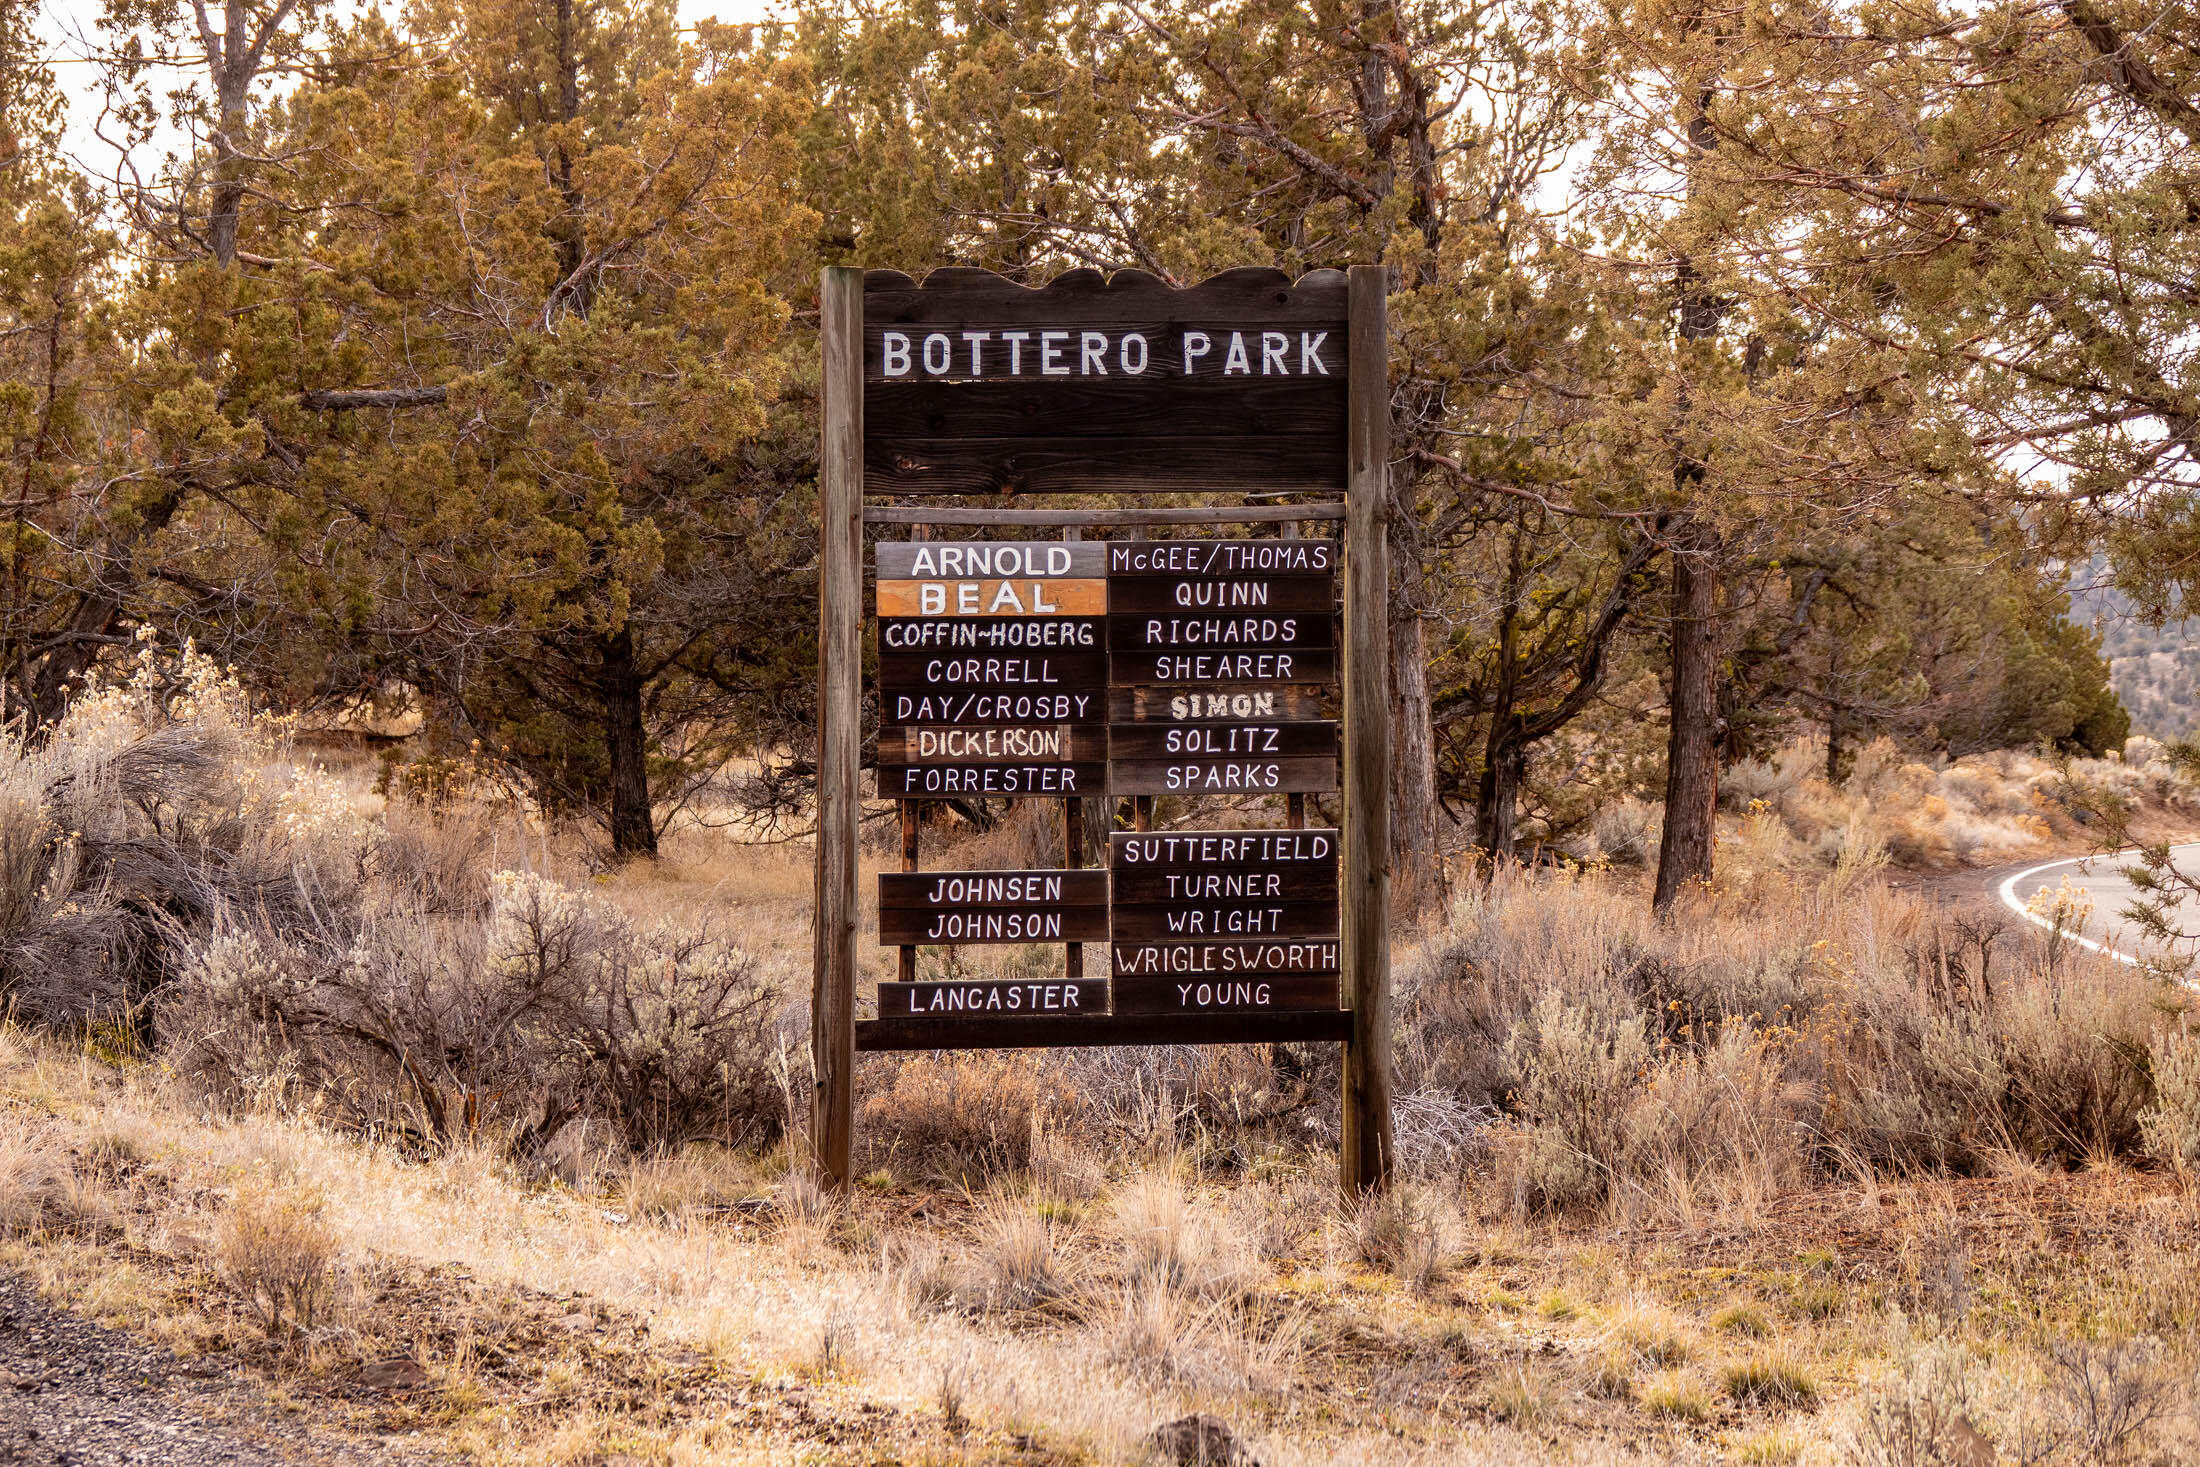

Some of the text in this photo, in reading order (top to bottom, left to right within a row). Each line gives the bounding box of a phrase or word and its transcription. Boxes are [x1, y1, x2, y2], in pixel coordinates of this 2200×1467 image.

[883, 332, 1329, 376] BOTTERO PARK
[912, 547, 1072, 575] ARNOLD
[921, 580, 1056, 615] BEAL
[1176, 582, 1268, 607] QUINN
[1147, 619, 1297, 644] RICHARDS
[927, 659, 1058, 683] CORRELL
[1155, 654, 1293, 679] SHEARER
[897, 693, 1089, 722] DAY/CROSBY
[1171, 692, 1274, 720] SIMON
[919, 729, 1060, 758] DICKERSON
[1166, 728, 1280, 752] SOLITZ
[905, 767, 1076, 792] FORRESTER
[1166, 764, 1280, 789] SPARKS
[1124, 836, 1329, 862] SUTTERFIELD
[929, 876, 1062, 903] JOHNSEN
[1166, 874, 1281, 898] TURNER
[928, 913, 1061, 939] JOHNSON
[1167, 909, 1283, 934] WRIGHT
[1116, 944, 1336, 973] WRIGLESWORTH
[910, 984, 1080, 1012] LANCASTER
[1177, 983, 1271, 1006] YOUNG
